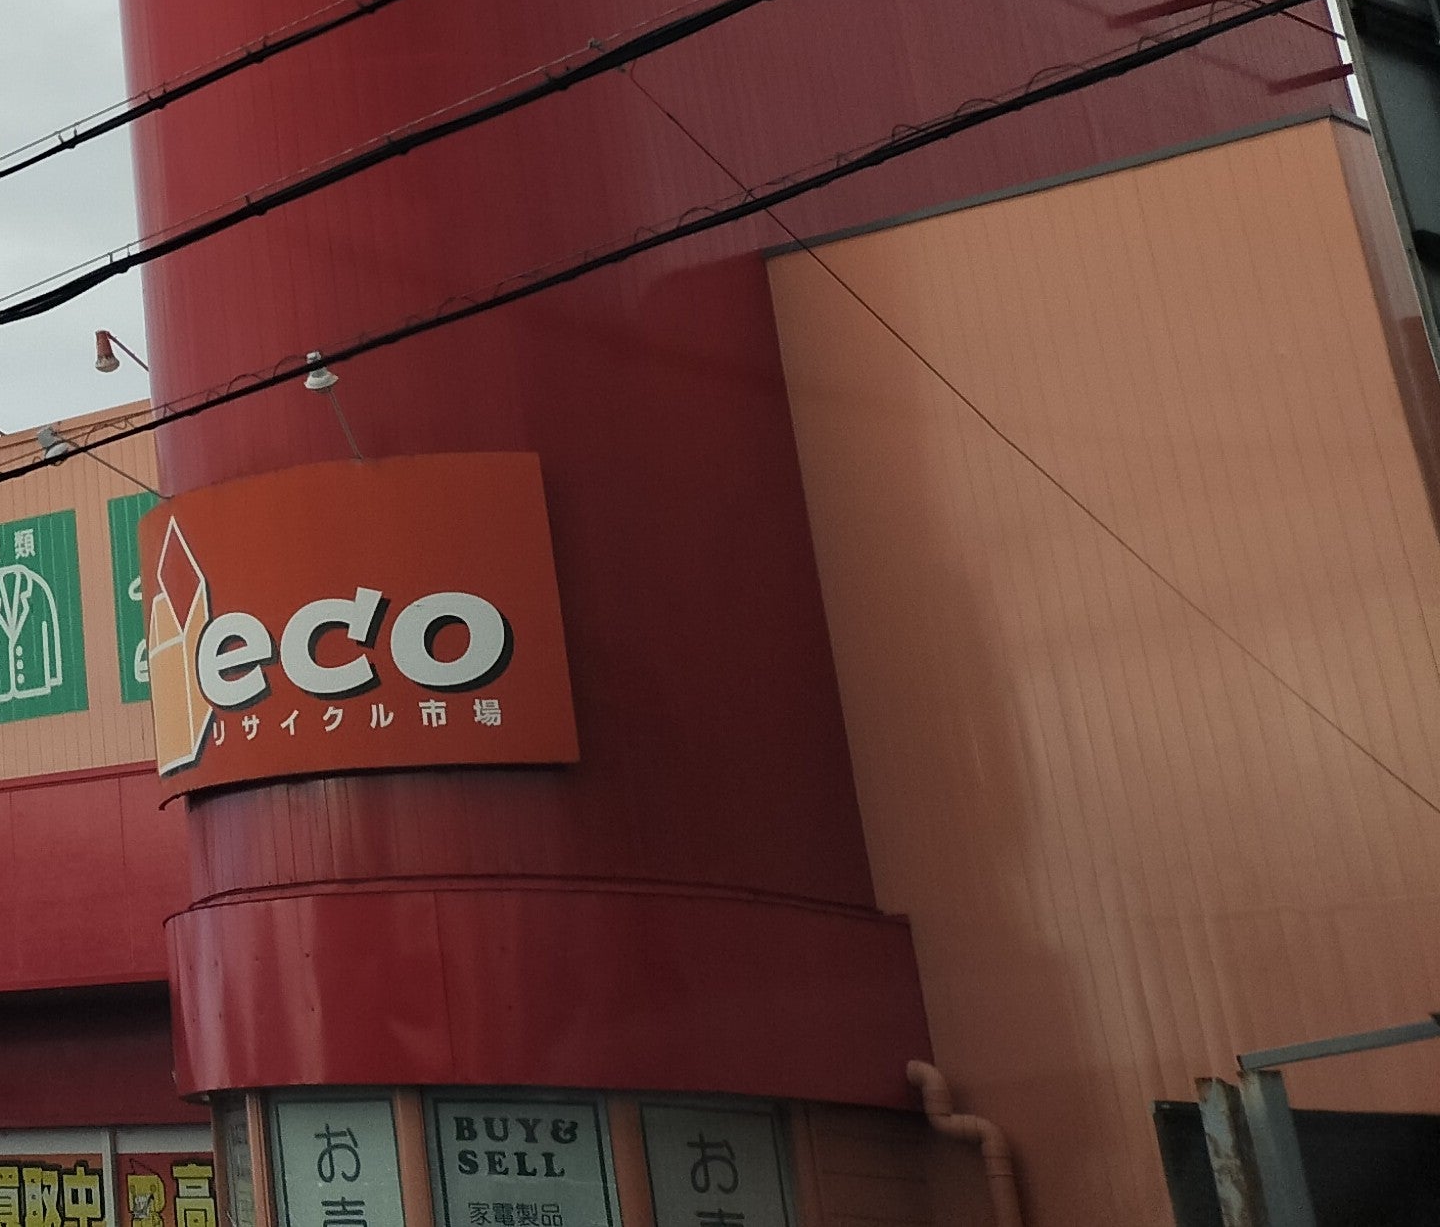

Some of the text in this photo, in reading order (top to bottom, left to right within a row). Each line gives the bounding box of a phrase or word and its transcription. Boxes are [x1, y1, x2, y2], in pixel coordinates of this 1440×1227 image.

[198, 586, 515, 710] eco
[212, 698, 503, 746] リサイクル市場
[457, 1149, 566, 1177] SELL
